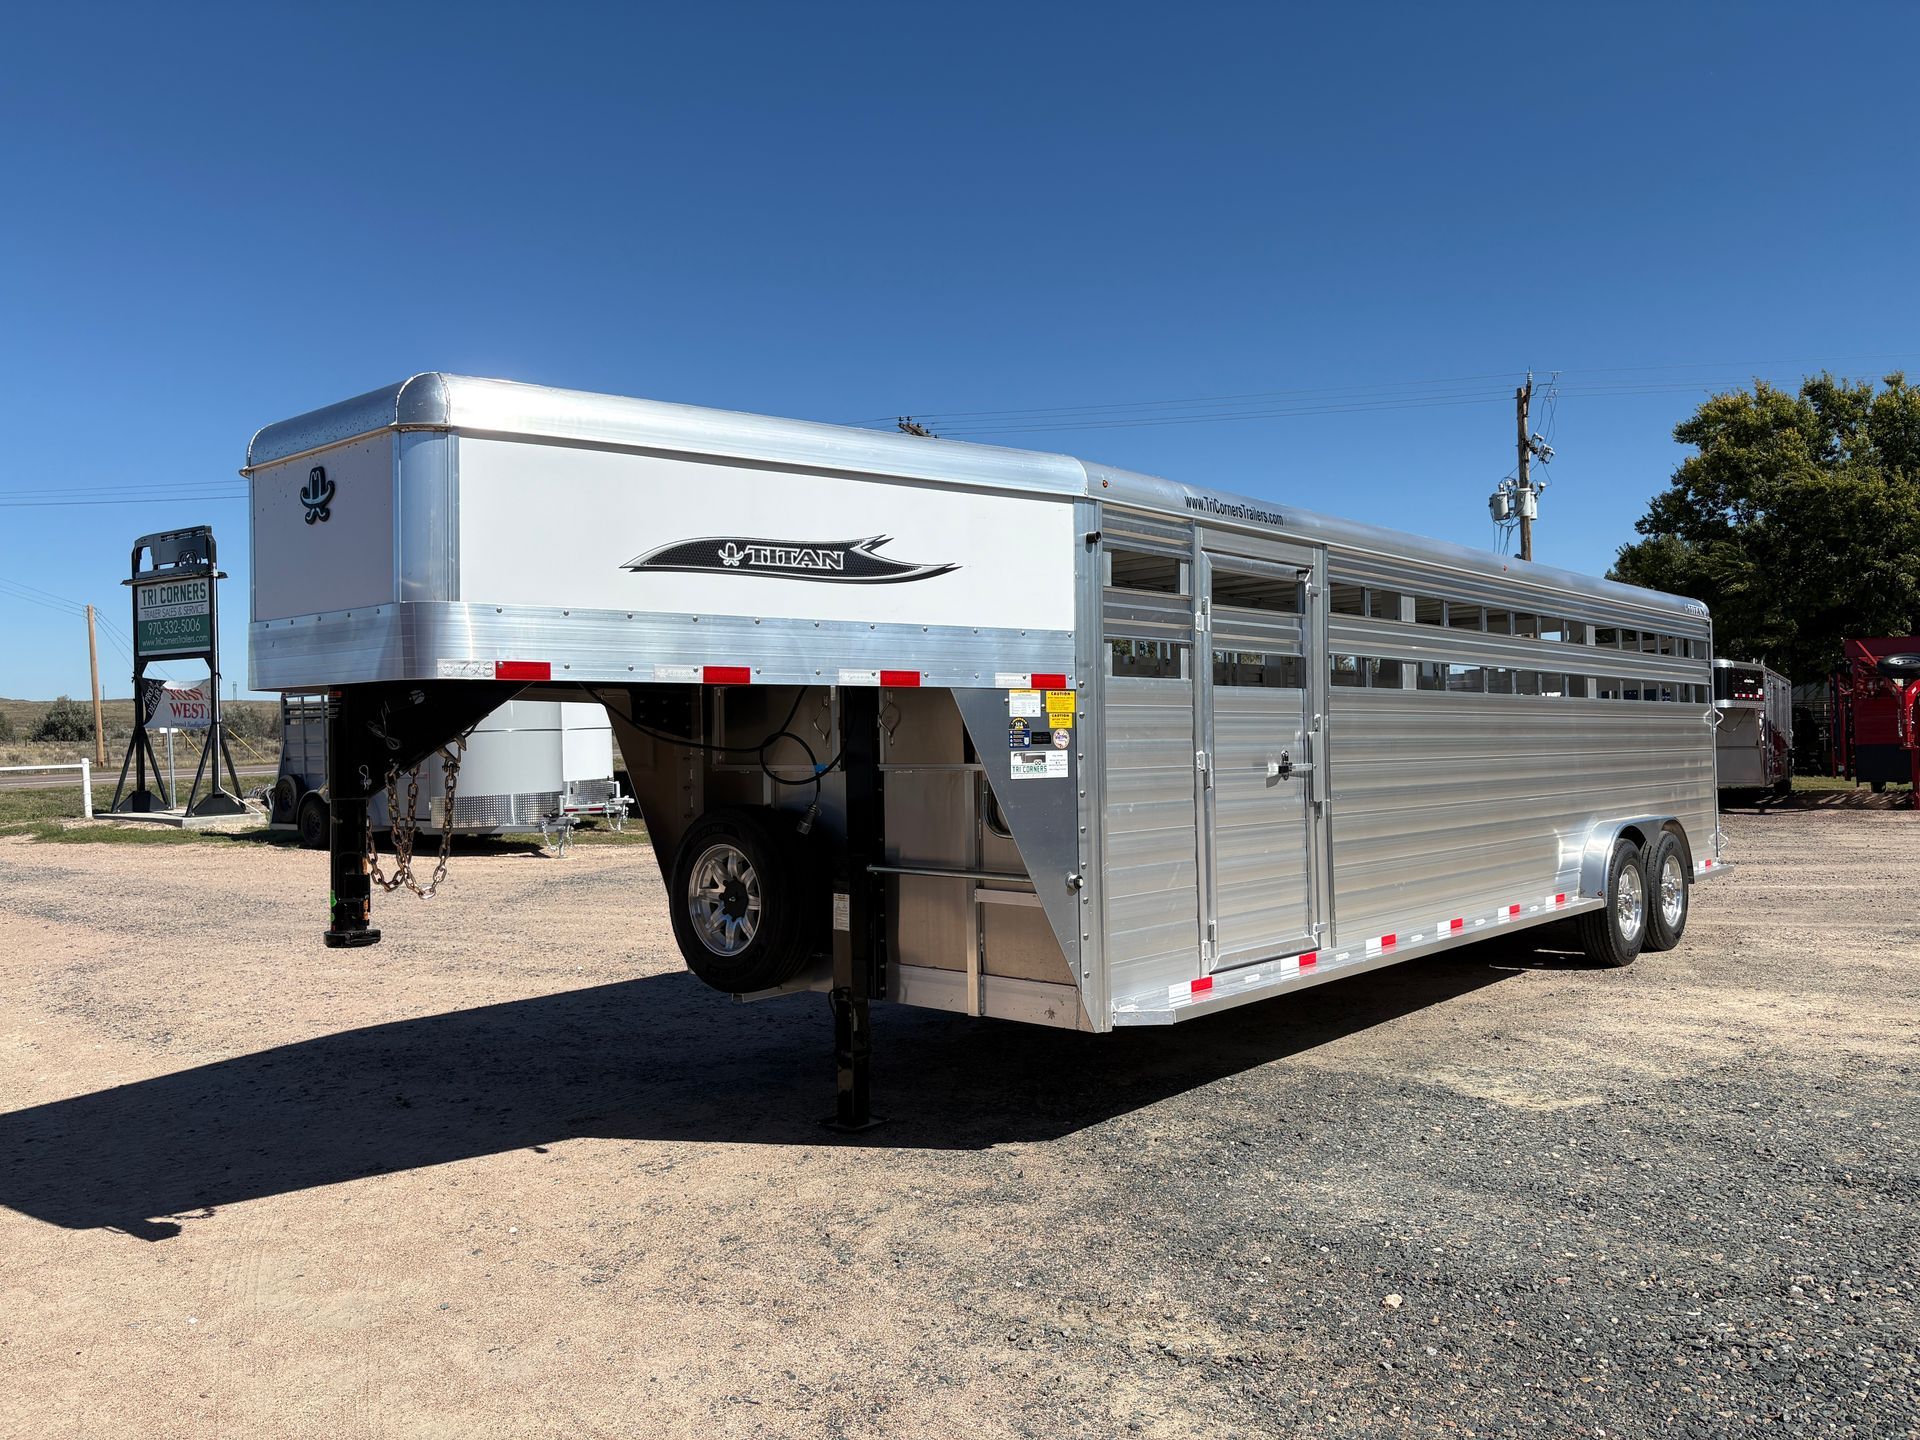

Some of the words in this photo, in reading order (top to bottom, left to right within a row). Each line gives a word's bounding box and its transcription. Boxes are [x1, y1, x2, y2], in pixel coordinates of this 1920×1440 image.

[1184, 495, 1284, 526] www.TriCornersTrailers.com
[744, 544, 845, 571] TITAN
[141, 588, 157, 606] TRI
[160, 582, 206, 604] CORNERS
[143, 609, 161, 619] TRAILER
[162, 607, 177, 618] SALES
[177, 606, 182, 616] &
[183, 604, 205, 615] SERVICE
[147, 617, 201, 636] 970-332-5006
[169, 702, 205, 719] WEST
[1012, 765, 1022, 774] TRI
[1023, 765, 1048, 773] CORNERS
